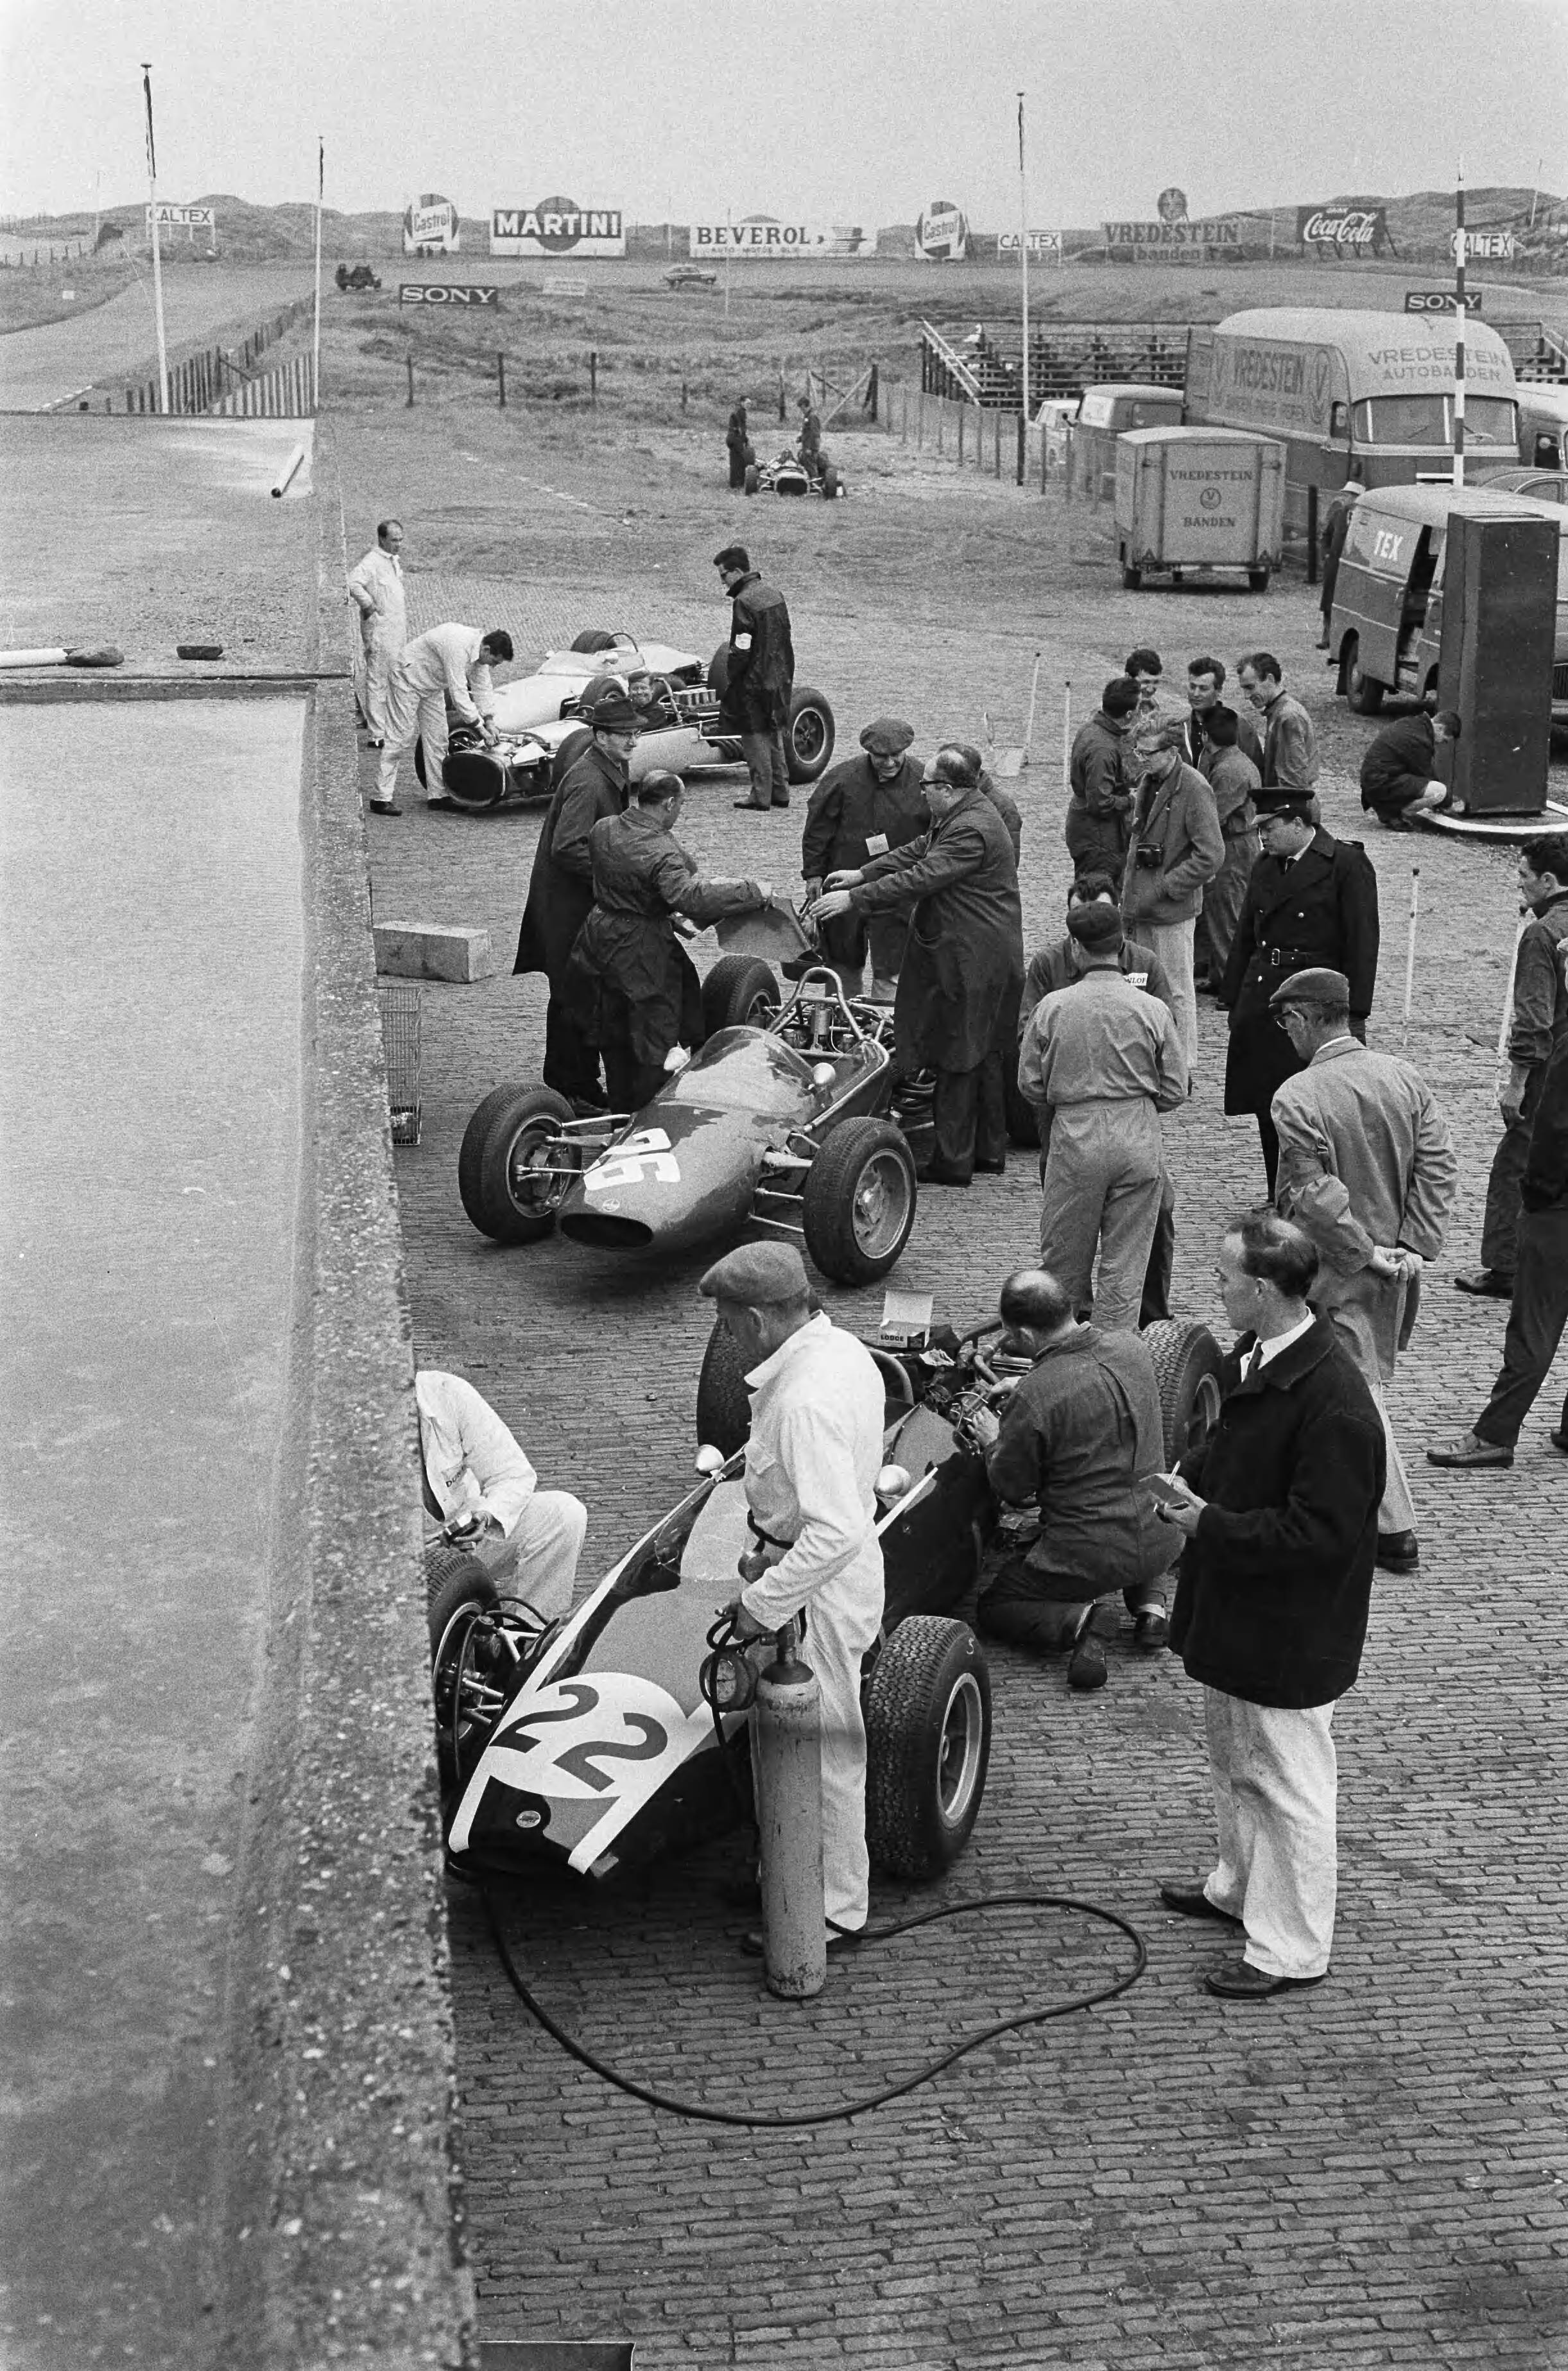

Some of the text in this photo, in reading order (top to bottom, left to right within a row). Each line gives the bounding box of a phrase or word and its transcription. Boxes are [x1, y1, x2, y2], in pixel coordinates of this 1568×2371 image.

[413, 210, 451, 232] Castrol
[497, 212, 618, 236] MARTINI
[697, 227, 811, 245] BEVEROL
[1000, 234, 1060, 249] CATEX
[1105, 224, 1239, 243] VREDESTEIN
[402, 286, 496, 304] SONY
[1383, 365, 1501, 381] AUTOBADEN
[1170, 470, 1252, 480] VREDESTEIN
[1184, 517, 1236, 527] BANDEN
[1374, 530, 1404, 562] TEX
[488, 1684, 668, 1792] 22
